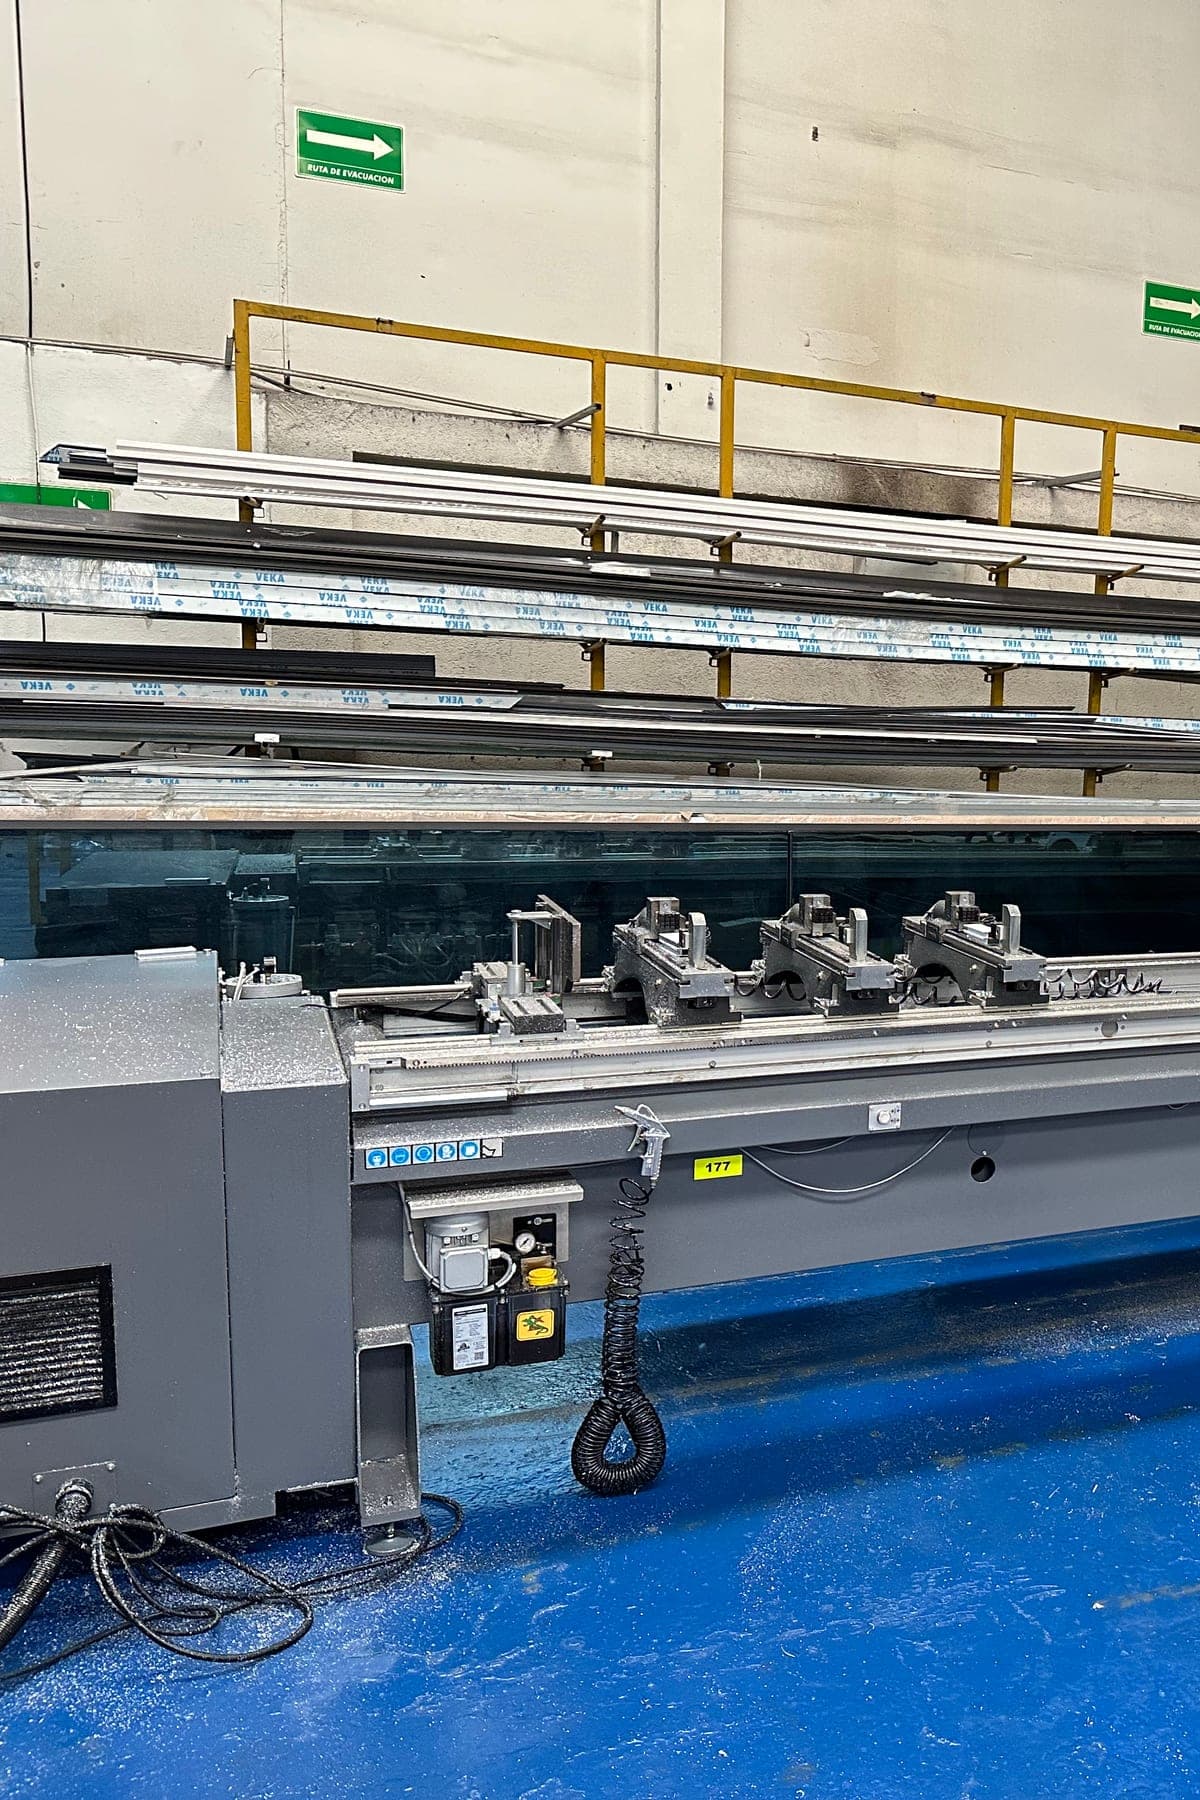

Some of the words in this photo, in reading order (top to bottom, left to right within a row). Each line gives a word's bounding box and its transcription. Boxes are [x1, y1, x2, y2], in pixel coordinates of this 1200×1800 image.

[307, 164, 328, 174] RUTA
[330, 168, 341, 176] DE
[342, 170, 395, 184] EVACUACION
[256, 573, 286, 583] VEKA
[209, 581, 240, 589] VEKA
[212, 590, 242, 600] VEKA
[319, 592, 347, 602] VEKA
[130, 595, 162, 606] VEKA
[419, 604, 446, 614] VEKA
[515, 607, 541, 616] VEKA
[643, 602, 667, 612] VEKA
[730, 606, 753, 614] VEKA
[241, 608, 270, 618] VEKA
[345, 609, 373, 619] VEKA
[445, 620, 471, 630] VEKA
[540, 621, 565, 631] VEKA
[607, 618, 631, 626] VEKA
[694, 619, 718, 629] VEKA
[777, 630, 800, 639] VEKA
[962, 625, 983, 634] VEKA
[630, 633, 654, 641] VEKA
[717, 634, 740, 643] VEKA
[1099, 632, 1118, 641] VEKA
[1002, 639, 1022, 648] VEKA
[799, 645, 821, 653] VEKA
[951, 653, 971, 661] VEKA
[1021, 652, 1040, 660] VEKA
[1088, 659, 1107, 667] VEKA
[19, 680, 53, 691] VEKA
[239, 687, 268, 697] VEKA
[438, 695, 464, 705] VEKA
[706, 1161, 731, 1173] 177
